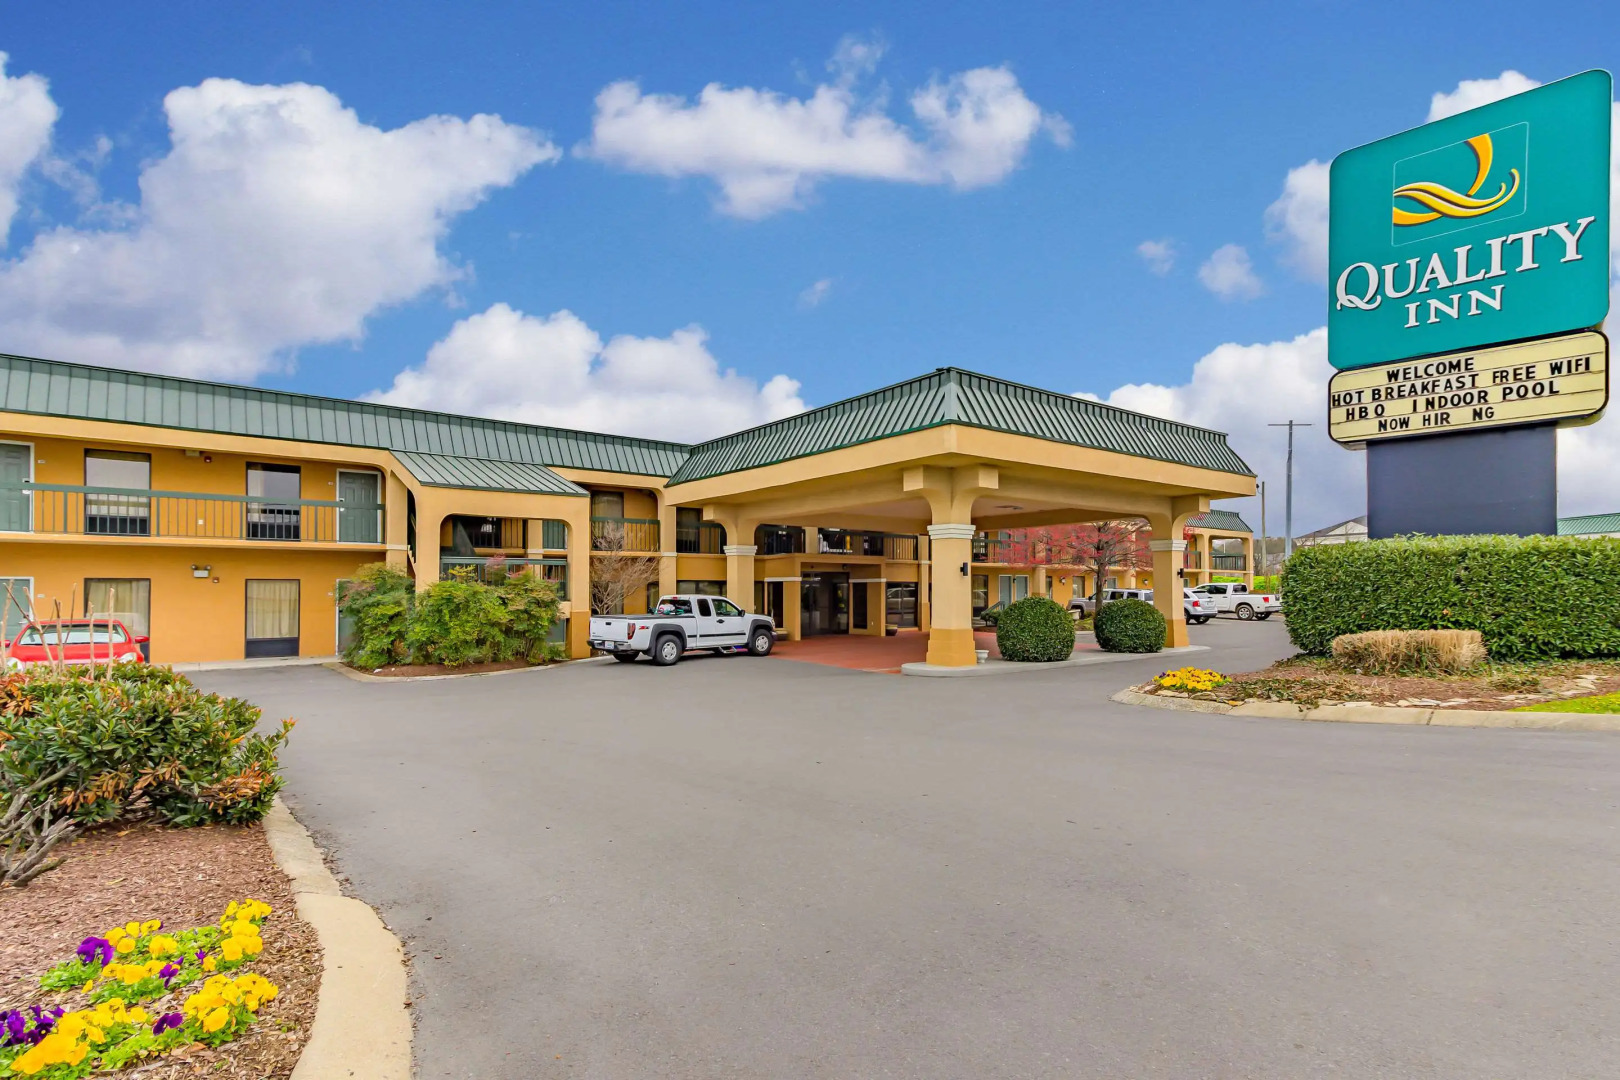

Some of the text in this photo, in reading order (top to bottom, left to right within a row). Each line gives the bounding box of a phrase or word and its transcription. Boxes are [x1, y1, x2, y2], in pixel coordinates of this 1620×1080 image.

[1336, 215, 1595, 310] QUALITY
[1404, 284, 1505, 328] INN
[1331, 357, 1591, 407] HOT BREAKFAST FREE WIFI
[1386, 357, 1475, 383] WELCOME
[1345, 404, 1385, 421] HBO
[1502, 380, 1560, 401] POOL
[1378, 416, 1410, 432] NOW
